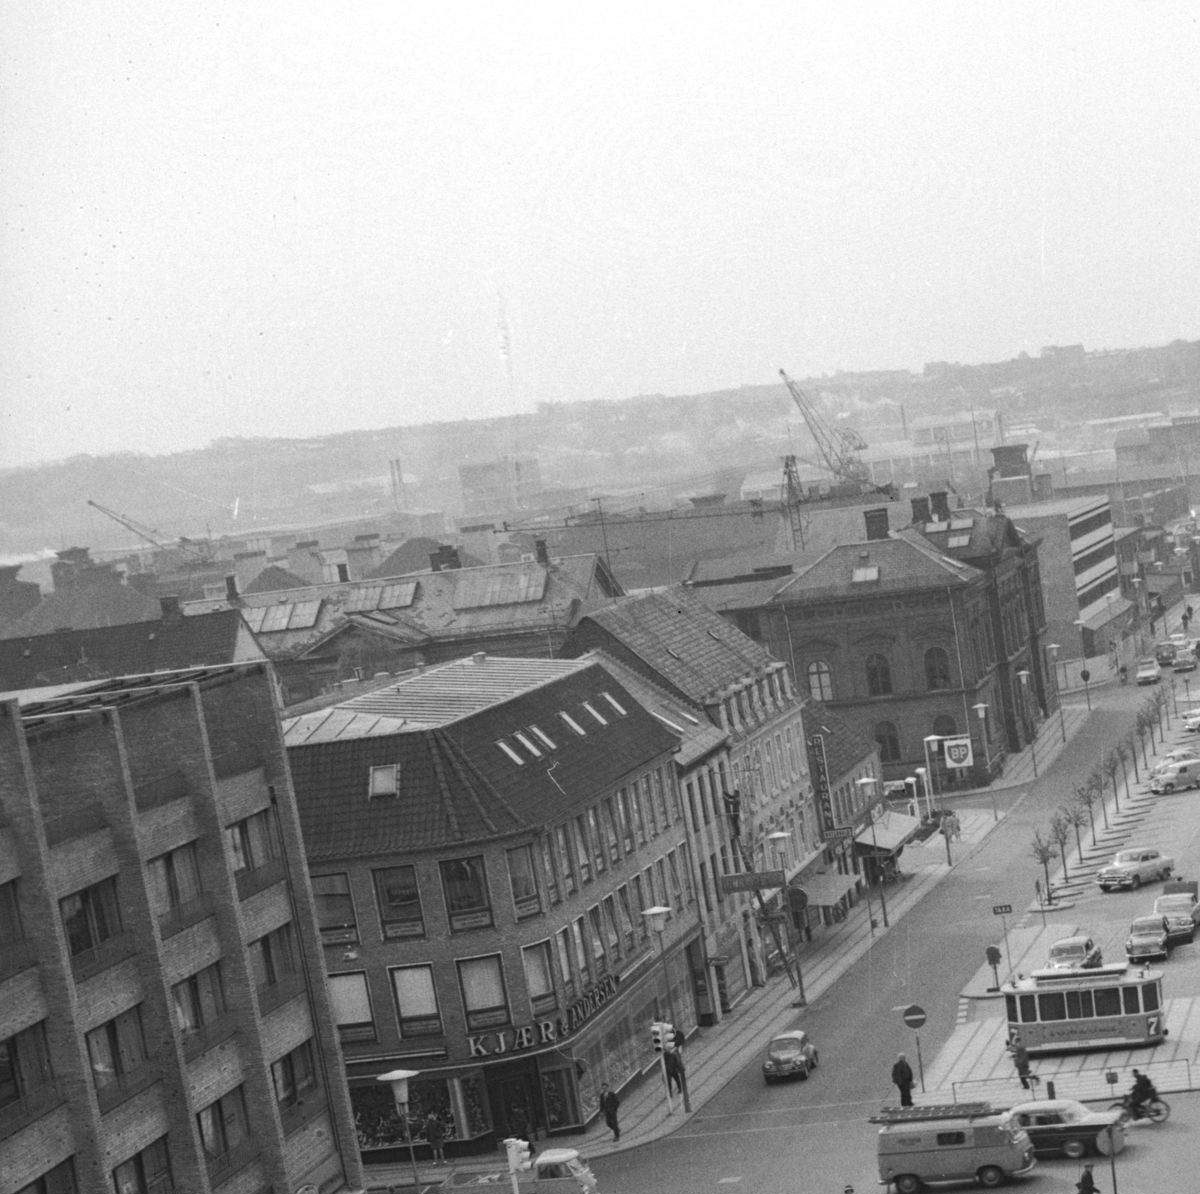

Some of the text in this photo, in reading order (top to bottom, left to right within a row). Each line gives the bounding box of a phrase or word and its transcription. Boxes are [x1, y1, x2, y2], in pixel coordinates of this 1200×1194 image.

[950, 746, 967, 760] BP
[813, 737, 833, 827] RESTAURANT
[467, 1020, 558, 1058] KJÆR
[568, 974, 618, 1031] ANDERSEN
[1147, 1017, 1159, 1036] 7
